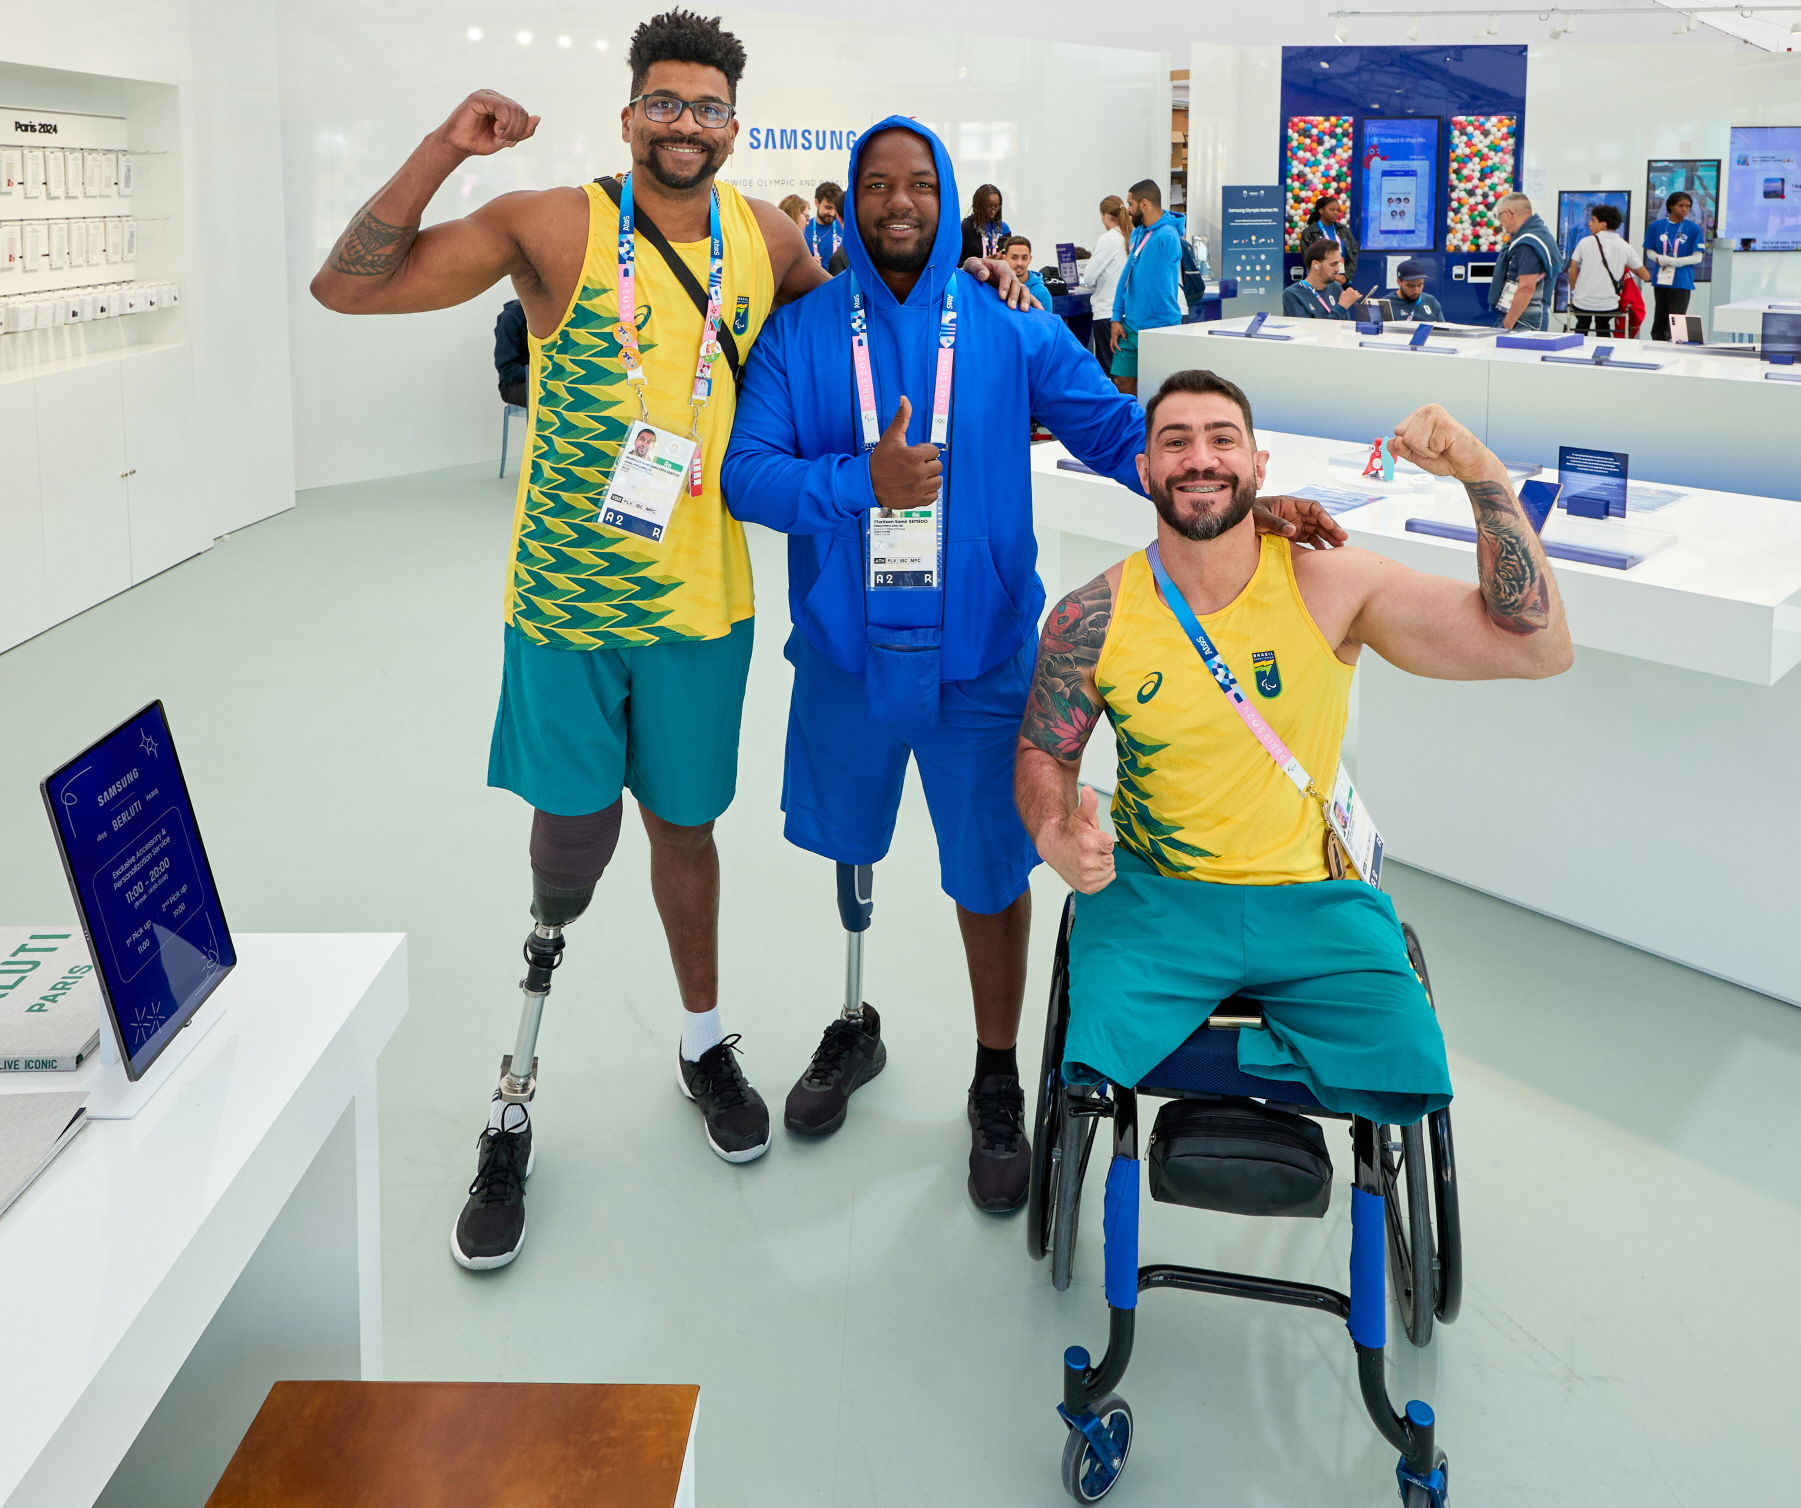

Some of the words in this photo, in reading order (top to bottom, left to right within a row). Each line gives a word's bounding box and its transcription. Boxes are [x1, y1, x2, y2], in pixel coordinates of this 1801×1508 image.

[14, 121, 37, 132] Paris
[38, 123, 58, 134] 2024
[748, 127, 857, 151] SAMSUNG
[757, 179, 796, 187] OLYMPIC
[622, 215, 630, 231] Atos
[622, 282, 630, 307] 2024
[946, 293, 954, 310] Atos
[857, 350, 867, 375] 2024
[940, 353, 949, 381] PARIS
[861, 378, 871, 407] PARIS
[937, 384, 947, 411] 2024
[605, 511, 614, 522] A
[615, 514, 624, 526] 2
[652, 527, 661, 538] R
[876, 574, 884, 584] A
[886, 574, 893, 584] 2
[924, 573, 932, 583] R
[1196, 635, 1213, 655] Atos
[1243, 706, 1265, 733] 2024
[1263, 733, 1287, 761] PARIS
[97, 768, 139, 807] SAMSUNG
[111, 799, 142, 831] BERLUTI
[145, 787, 159, 802] PARIS
[112, 855, 136, 879] Exclusive
[136, 832, 162, 858] Accessory
[161, 828, 167, 836] &
[113, 852, 153, 891] Personalization
[152, 836, 171, 856] Service
[125, 881, 144, 904] 11:00
[149, 857, 170, 882] 20:00
[180, 884, 188, 894] up
[173, 902, 186, 918] 19:00
[143, 919, 152, 930] up
[137, 938, 150, 955] 11:00
[0, 933, 72, 999] LUTI
[25, 964, 93, 1013] PARIS
[0, 1060, 20, 1070] IVE
[24, 1060, 58, 1070] ICONIC
